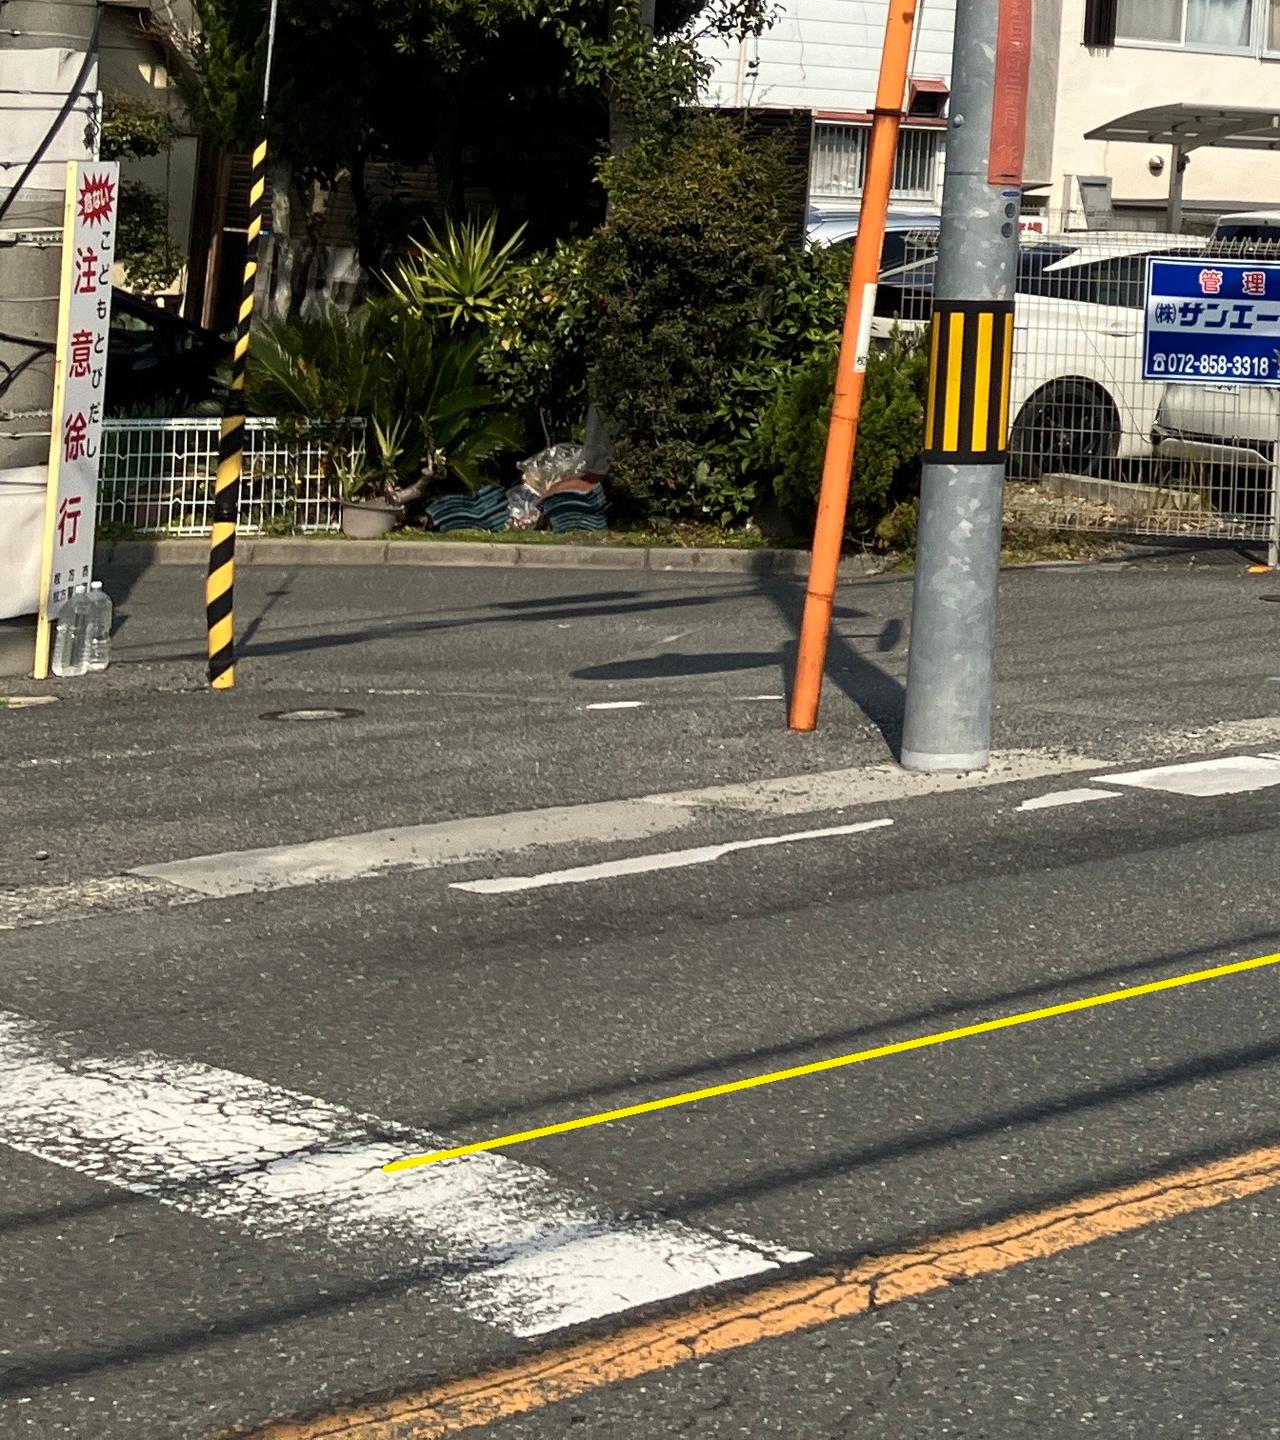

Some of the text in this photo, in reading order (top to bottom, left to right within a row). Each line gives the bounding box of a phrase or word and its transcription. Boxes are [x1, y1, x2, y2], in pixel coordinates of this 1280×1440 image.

[86, 230, 111, 459] こどもとびだし
[1200, 270, 1266, 295] 管理
[57, 246, 99, 548] 注意徐行
[1168, 353, 1269, 377] 072-858-3318
